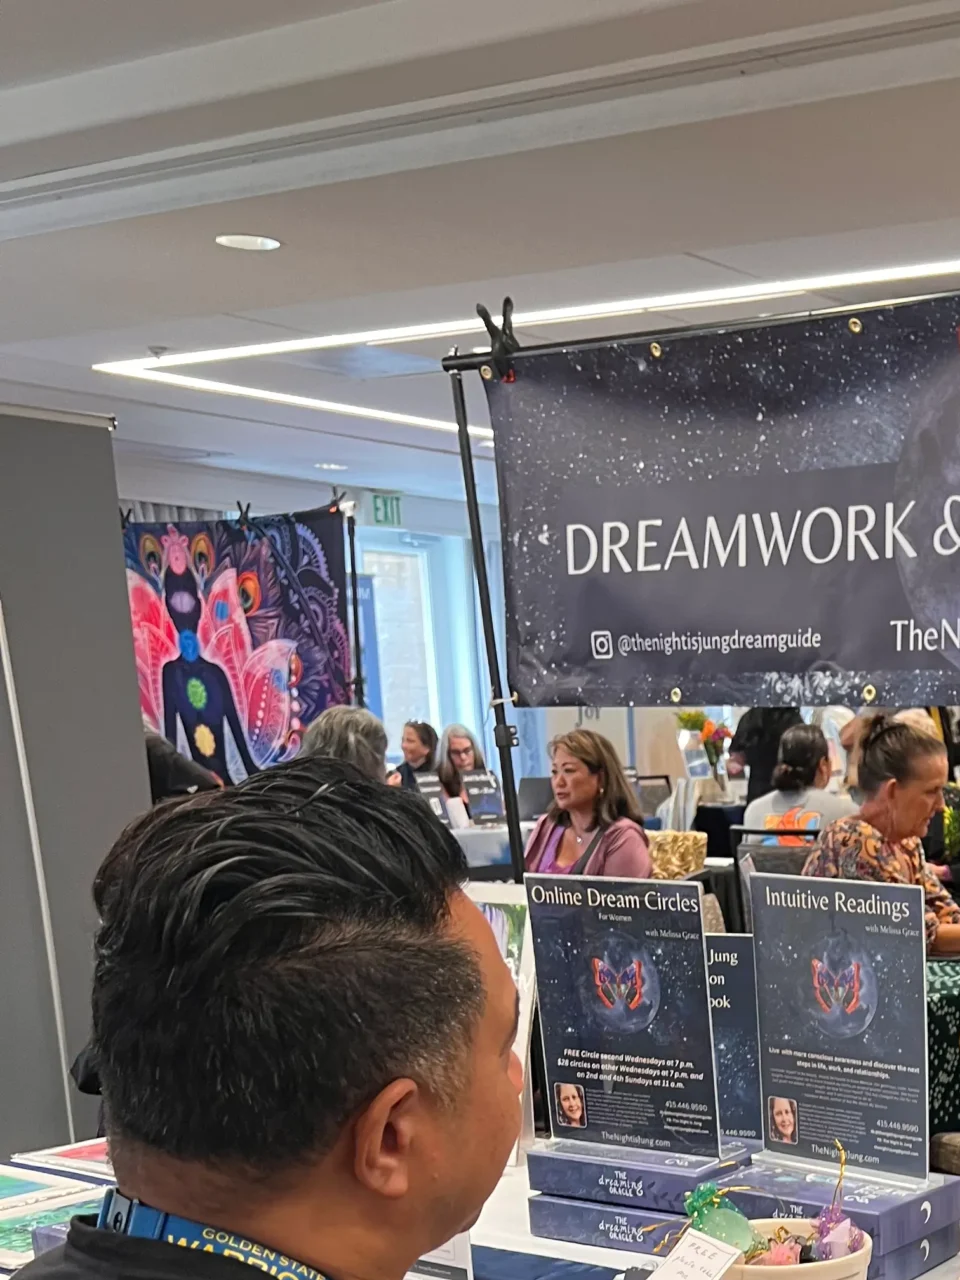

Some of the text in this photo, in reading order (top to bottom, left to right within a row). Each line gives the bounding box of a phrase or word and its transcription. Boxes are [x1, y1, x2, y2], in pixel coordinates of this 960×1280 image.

[373, 495, 401, 526] EXIT
[566, 500, 918, 577] DREAMWORK
[617, 629, 822, 657] @thenightisjungdreamguide
[531, 884, 699, 913] Online Dream Circles
[766, 886, 910, 922] Intuitive Readings
[598, 913, 632, 922] For Women
[645, 929, 699, 941] with Melissa Grace
[865, 925, 920, 937] with Melissa Grace
[708, 949, 738, 966] Jung
[563, 1048, 580, 1057] FREE
[581, 1050, 600, 1060] Circle
[600, 1052, 624, 1062] second
[624, 1054, 666, 1067] Wednesdays
[666, 1058, 674, 1066] at
[569, 1059, 591, 1070] circles
[591, 1062, 600, 1070] on
[601, 1062, 619, 1072] other
[619, 1065, 661, 1077] Wednesdays
[689, 1072, 704, 1081] and
[585, 1071, 598, 1080] 2nd
[599, 1073, 611, 1081] and
[625, 1076, 653, 1087] Sundays
[811, 1143, 880, 1165] TheNighJung.com
[614, 1170, 627, 1180] THE
[598, 1175, 644, 1197] dreaming
[609, 1186, 633, 1197] ORACLE
[789, 1204, 803, 1215] THE
[614, 1216, 628, 1225] THE
[598, 1220, 644, 1242] dreaming
[609, 1231, 633, 1243] ORACLE
[202, 1227, 276, 1262] GOLDEN
[688, 1242, 719, 1260] FREE
